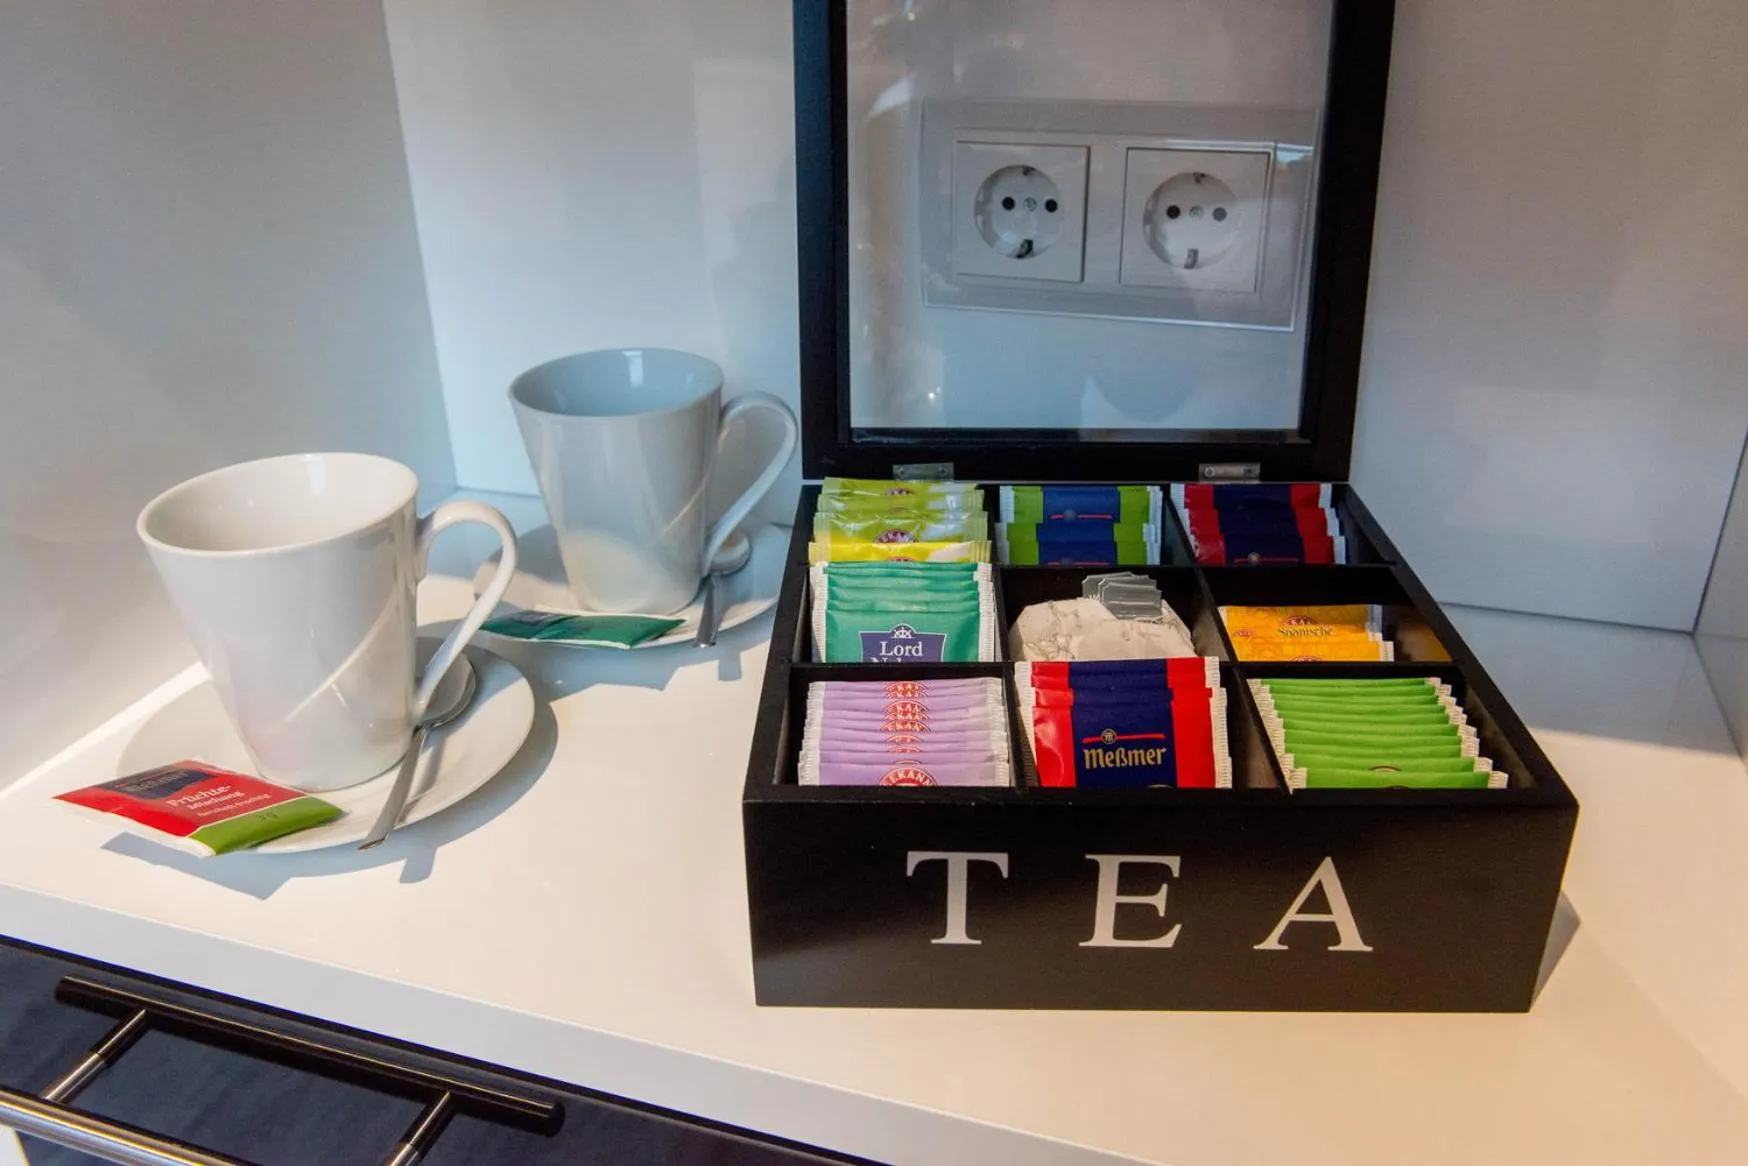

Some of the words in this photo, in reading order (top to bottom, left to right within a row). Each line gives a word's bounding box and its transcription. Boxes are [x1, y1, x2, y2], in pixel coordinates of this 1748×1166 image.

[879, 640, 924, 657] Lord
[1083, 747, 1167, 769] Meßmer
[906, 850, 1374, 952] TEA
